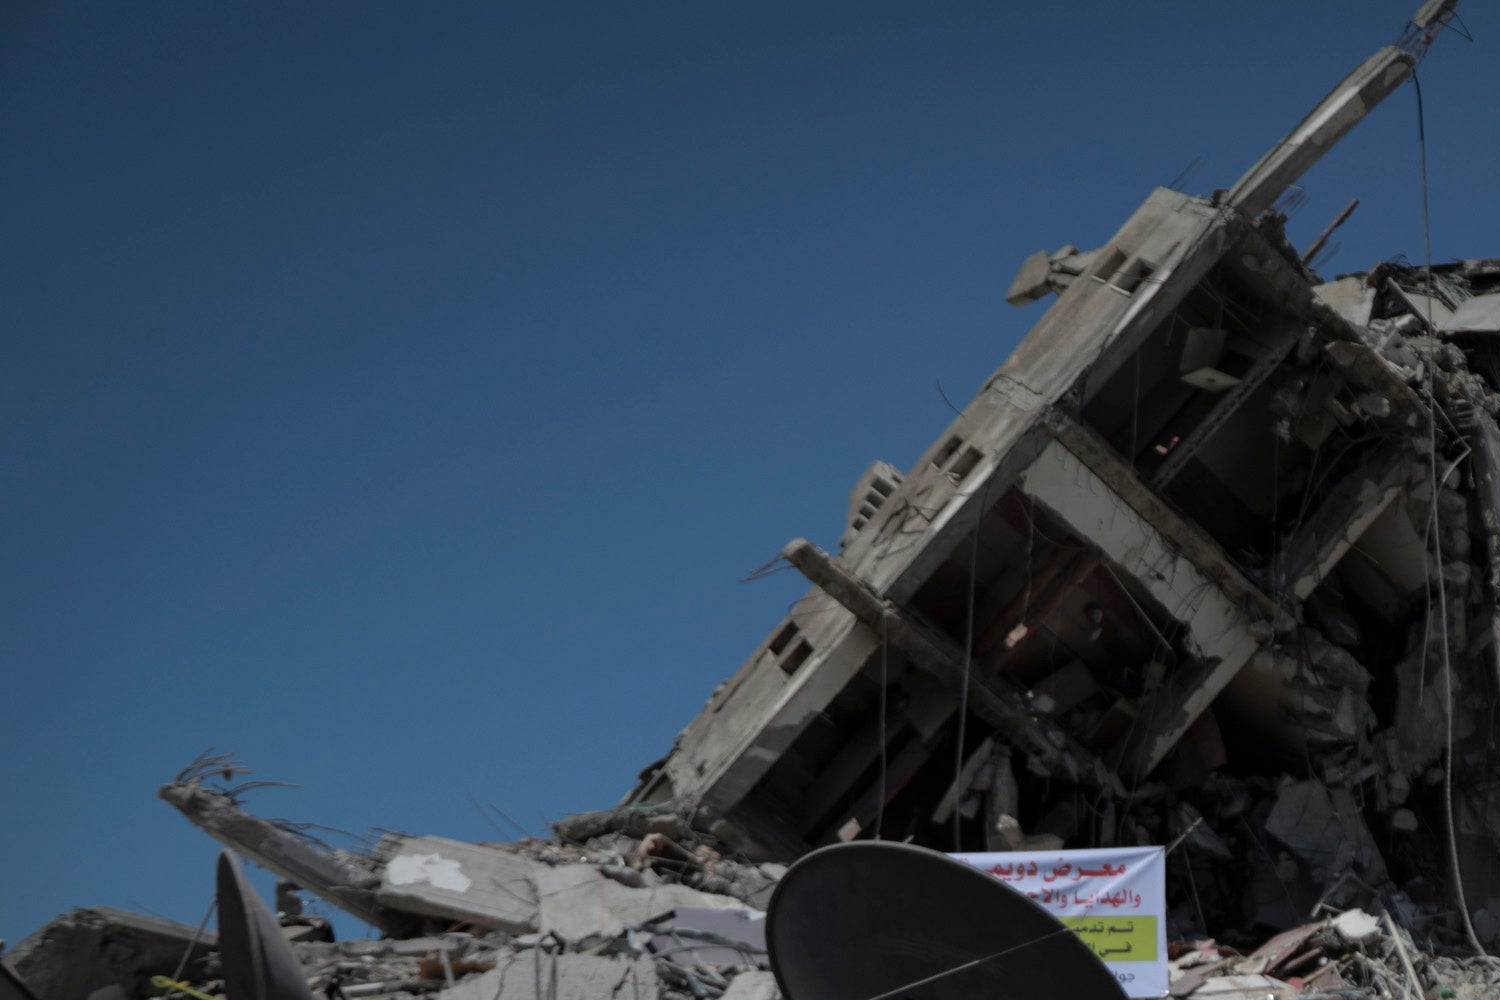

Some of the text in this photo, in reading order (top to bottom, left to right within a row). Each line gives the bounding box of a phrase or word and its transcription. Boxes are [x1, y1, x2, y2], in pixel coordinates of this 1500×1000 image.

[1043, 857, 1126, 882] معرض
[1074, 888, 1142, 908] والهدايا
[1108, 920, 1134, 936] تم
[1098, 941, 1133, 958] في
[1114, 971, 1136, 985] جوا
